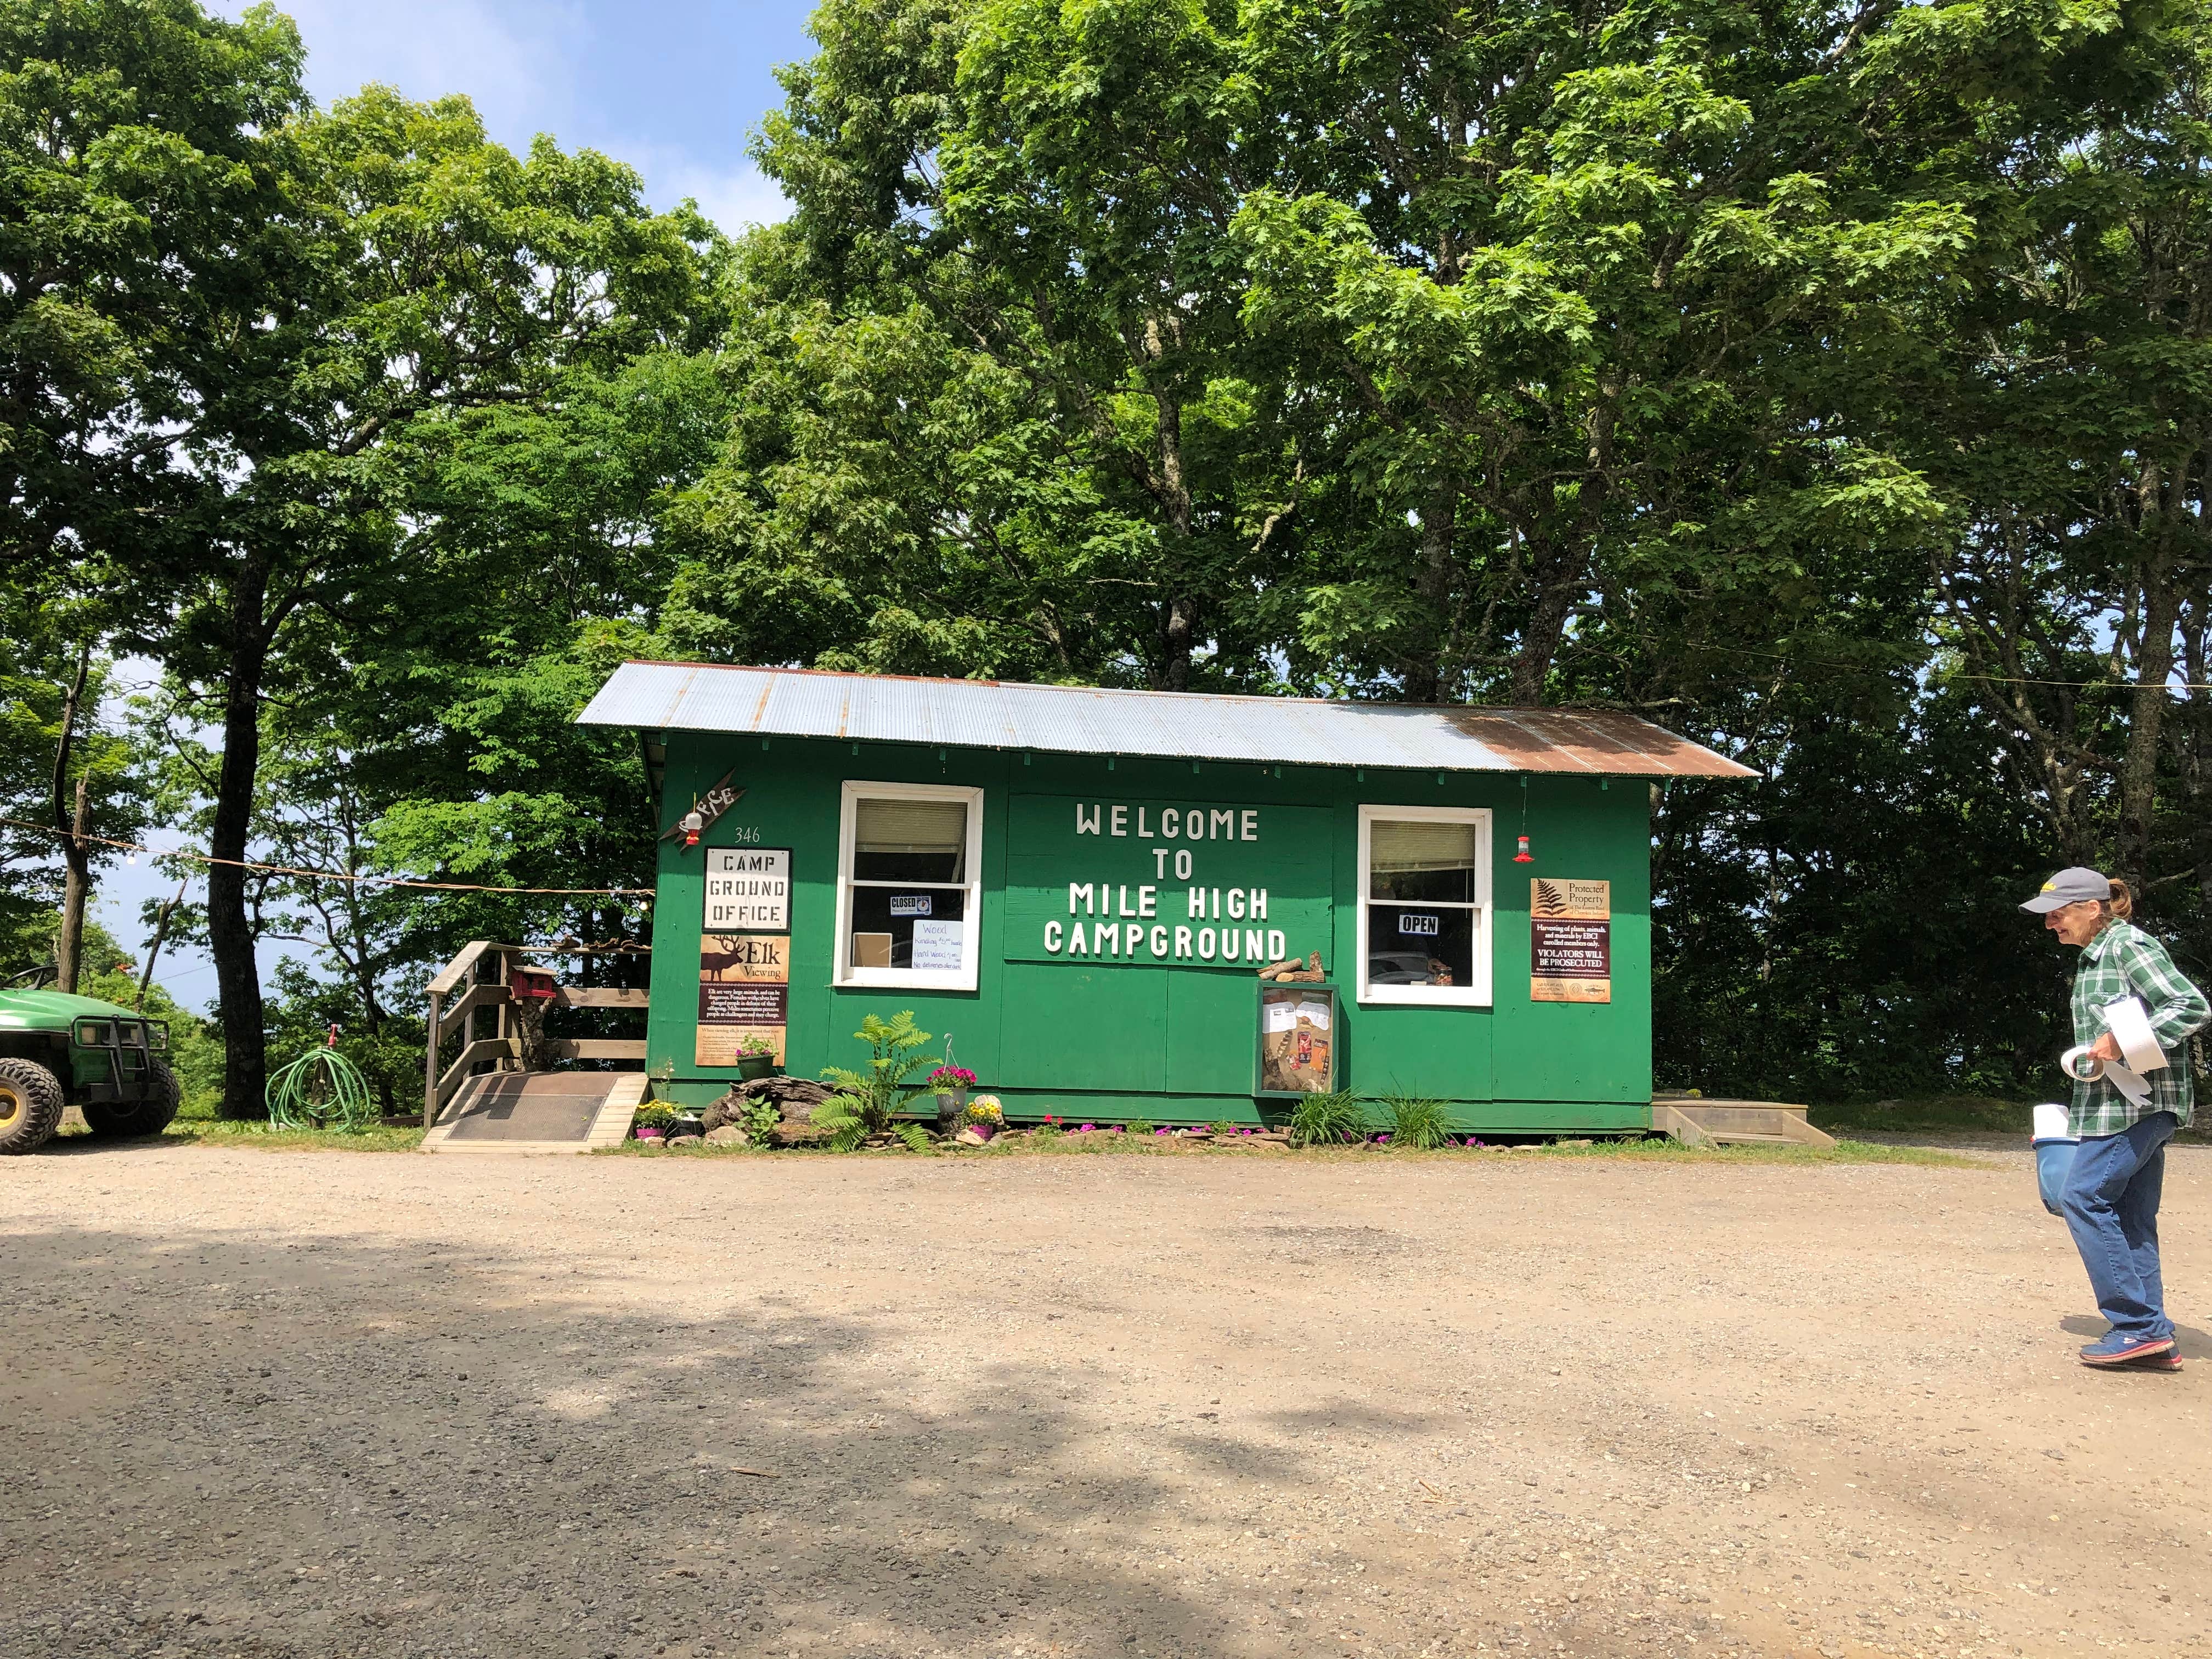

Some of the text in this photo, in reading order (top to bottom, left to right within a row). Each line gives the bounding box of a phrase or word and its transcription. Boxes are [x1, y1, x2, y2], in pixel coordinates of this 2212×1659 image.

[1076, 803, 1258, 840] WELCOME
[735, 827, 760, 843] 346
[724, 855, 775, 871] CAMP
[1152, 849, 1192, 879] TO
[710, 880, 784, 896] GROUND
[1569, 883, 1604, 893] Protected
[891, 898, 916, 908] CLOSED
[1069, 883, 1267, 919] MILE HIGH
[1569, 893, 1604, 906] Property
[713, 905, 780, 921] OFFICE
[923, 924, 946, 934] Wood
[1402, 916, 1436, 933] OPEN
[1537, 924, 1564, 934] Harvesting
[1044, 921, 1285, 961] CAMPGROUND
[1587, 940, 1600, 949] only.
[744, 941, 781, 964] Elk
[913, 949, 928, 958] Hard
[1537, 949, 1584, 958] VIOLATORS
[1550, 959, 1602, 967] PROSECUTED
[744, 966, 781, 980] Viewing
